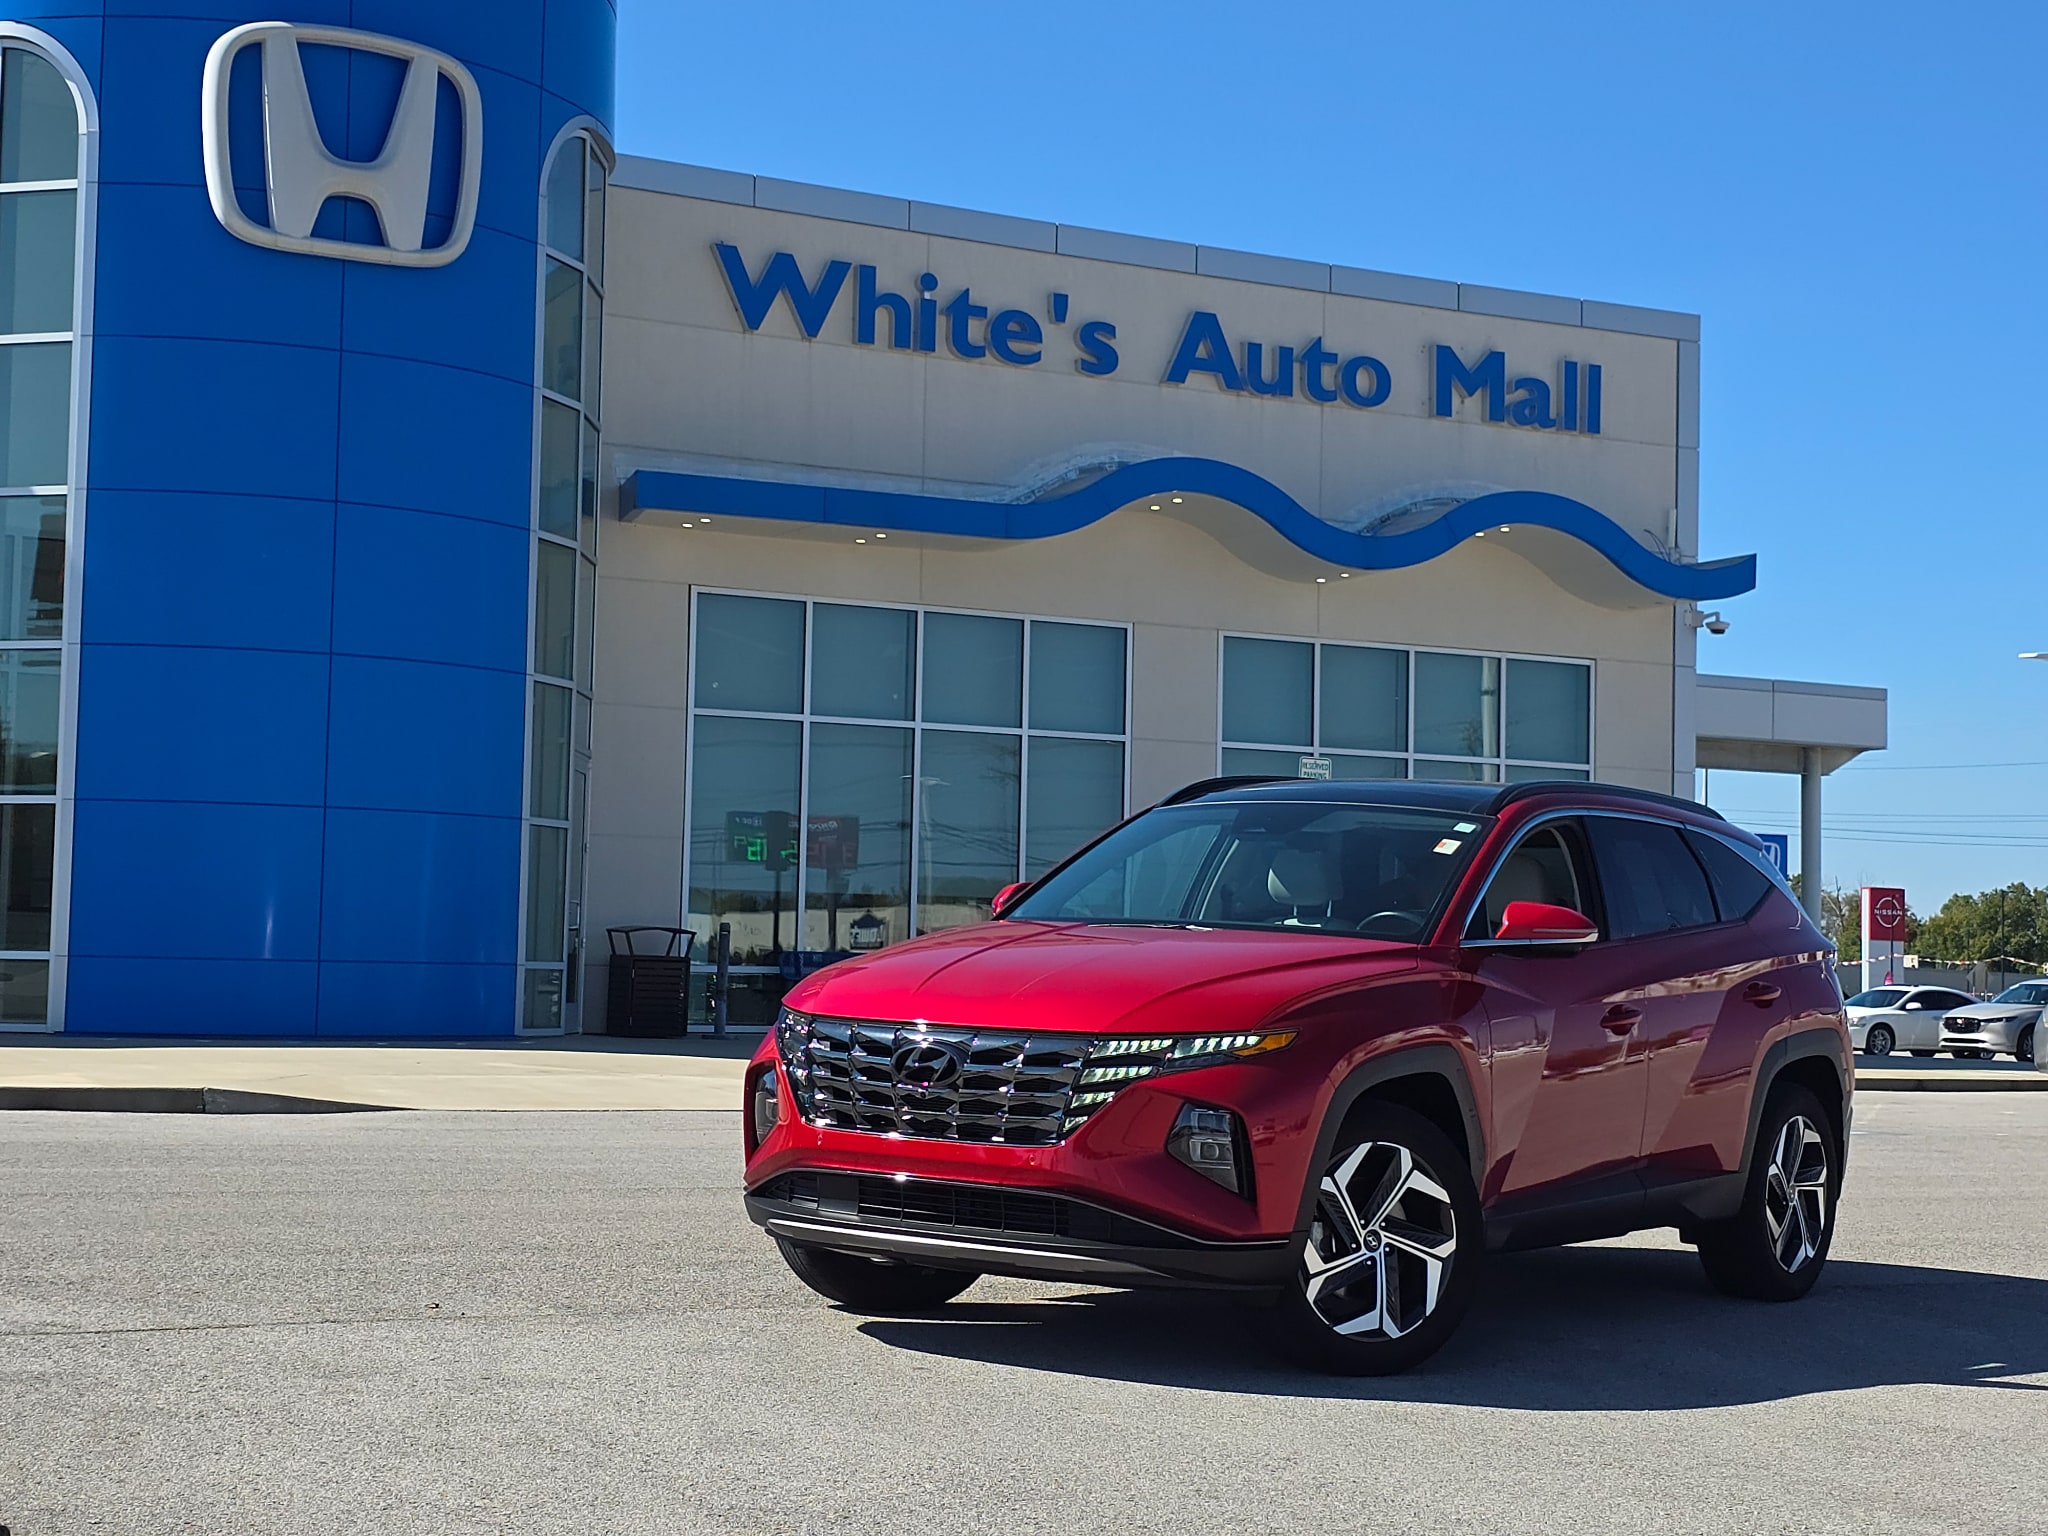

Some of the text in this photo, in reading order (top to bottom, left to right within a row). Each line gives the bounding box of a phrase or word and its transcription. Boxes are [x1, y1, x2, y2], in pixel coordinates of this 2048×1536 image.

[713, 243, 1602, 434] White's Auto Mall
[1873, 908, 1903, 916] NISSAN
